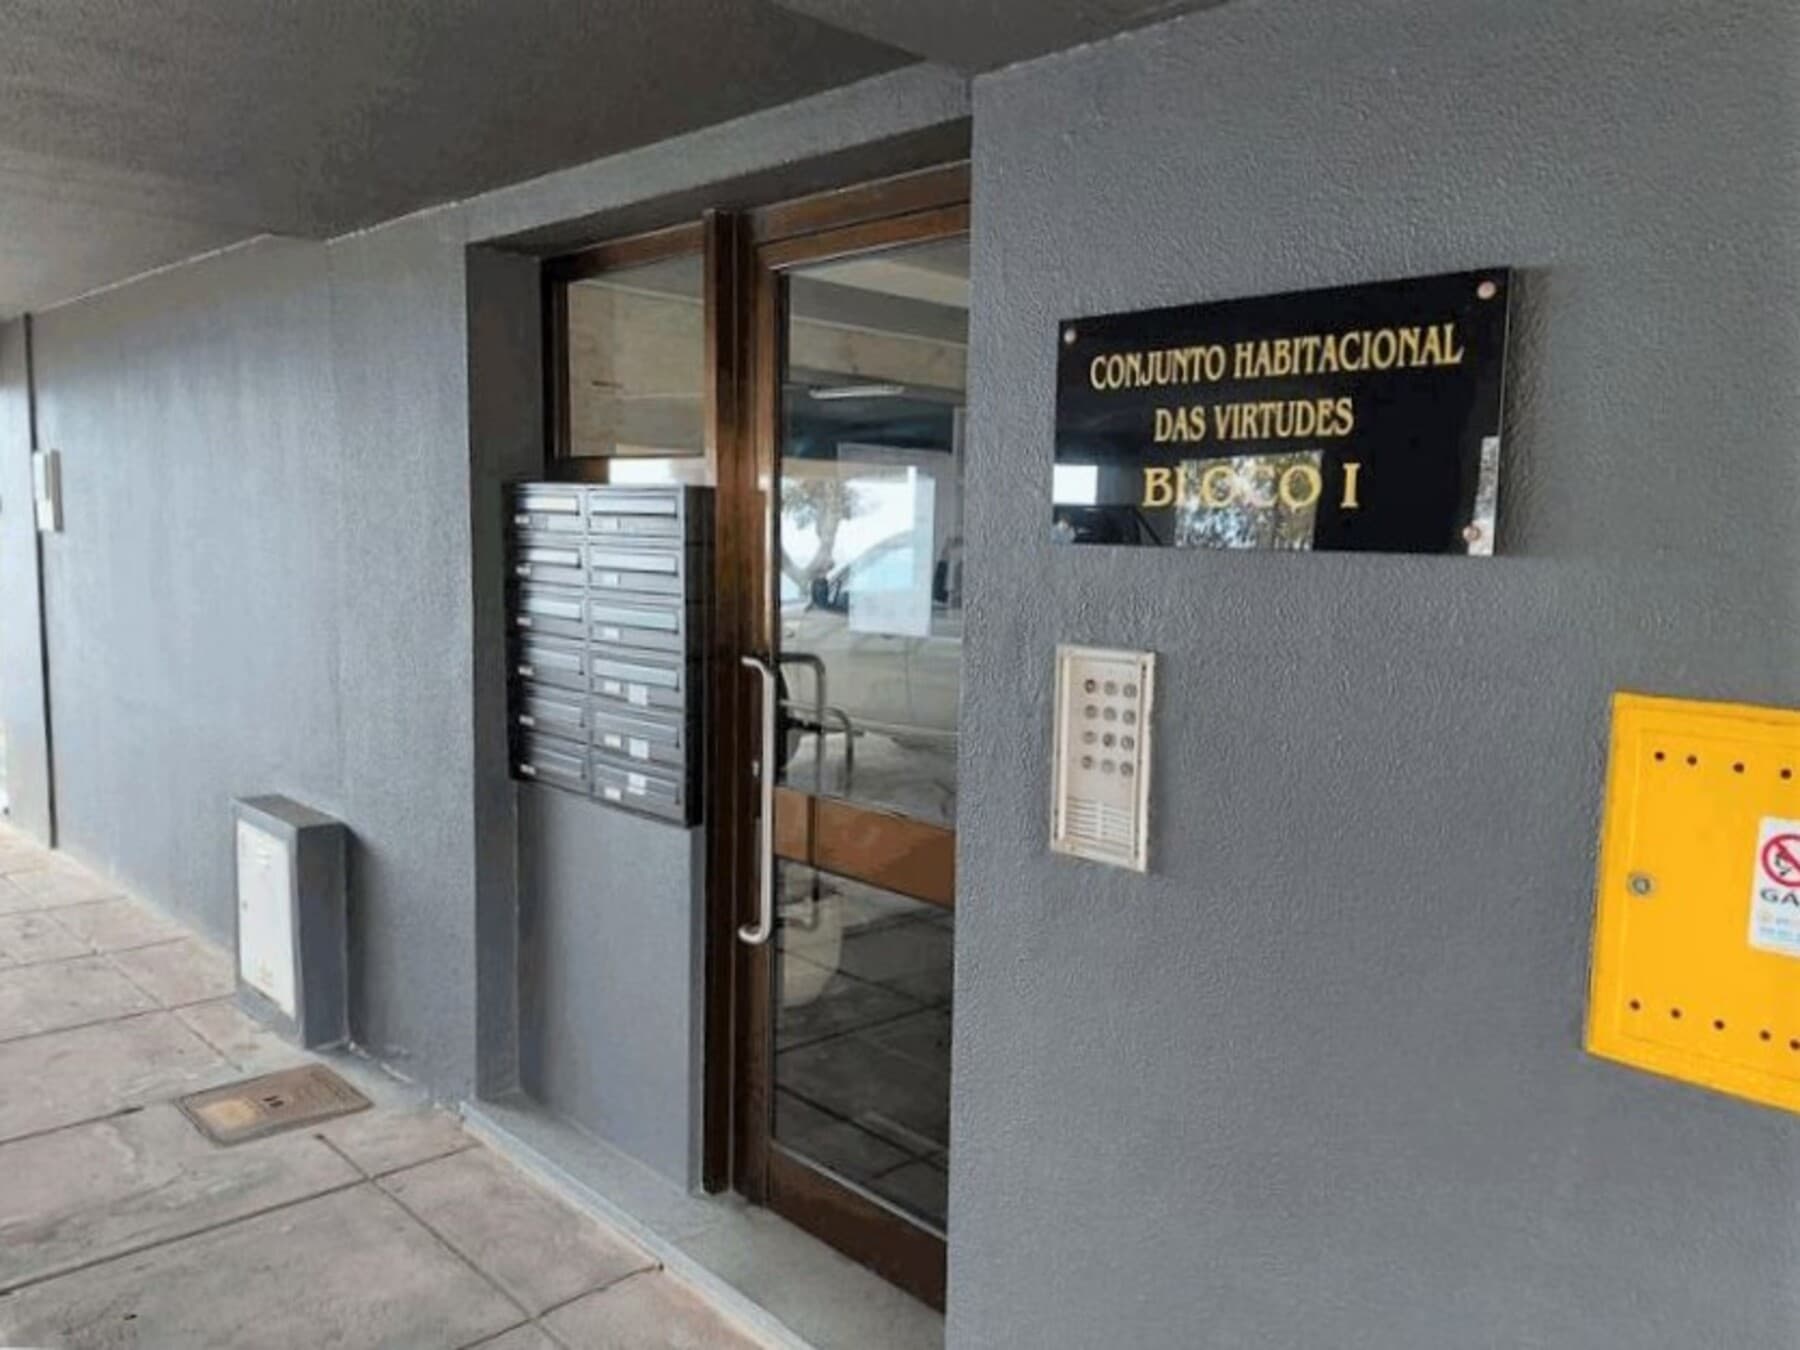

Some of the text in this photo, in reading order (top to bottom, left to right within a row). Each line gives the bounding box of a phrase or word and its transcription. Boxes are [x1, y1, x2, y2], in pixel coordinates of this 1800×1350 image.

[1090, 323, 1464, 390] CONJUNTO HABITACIONAL
[1154, 397, 1355, 443] DAS VIRTUDES
[1340, 462, 1361, 509] I
